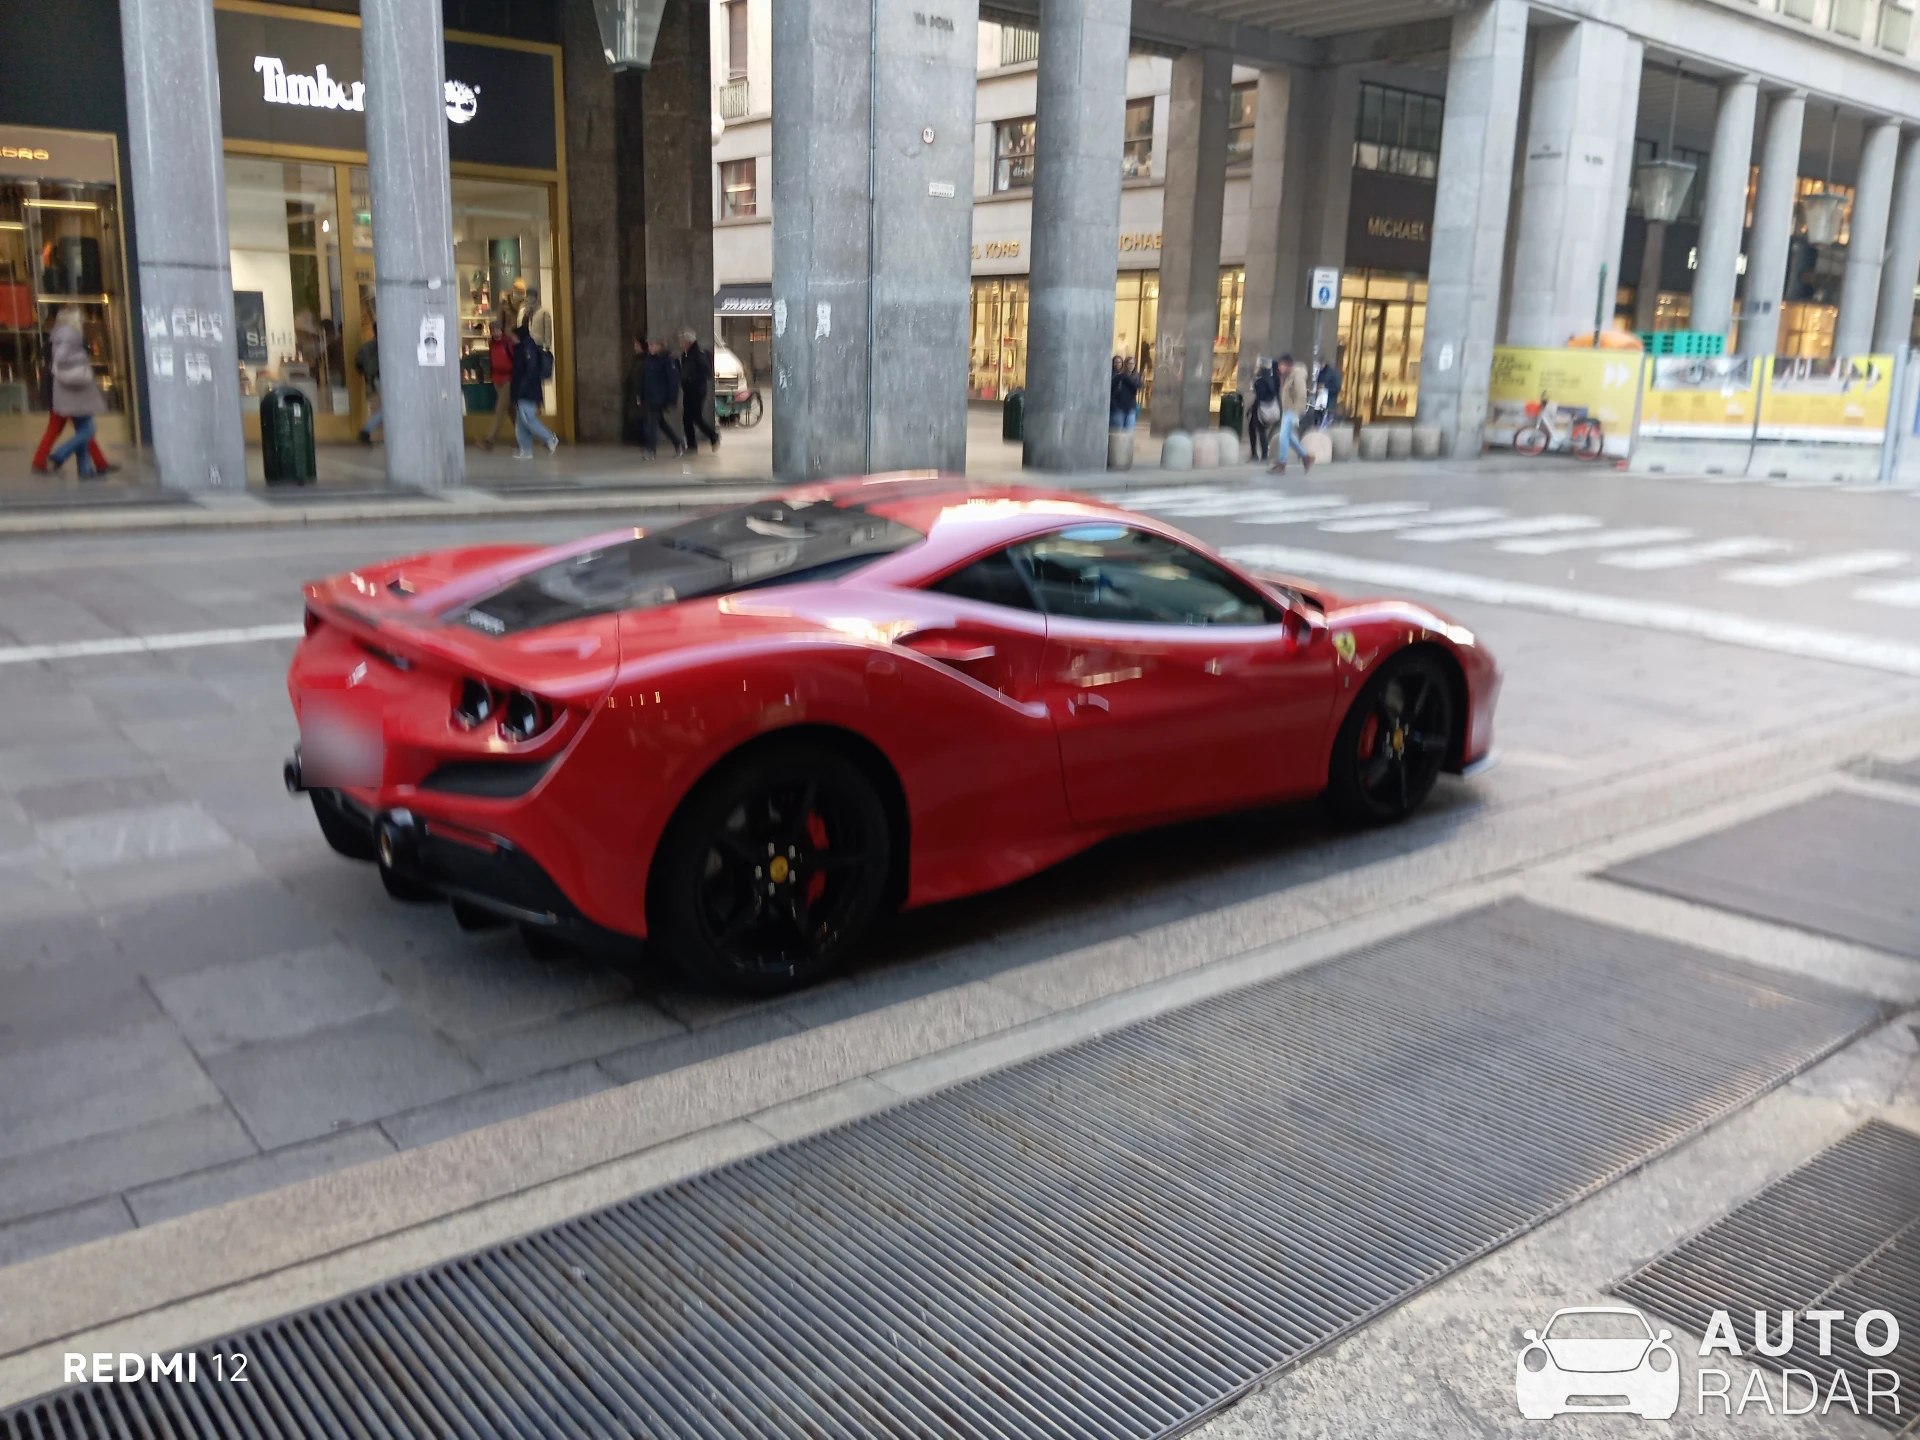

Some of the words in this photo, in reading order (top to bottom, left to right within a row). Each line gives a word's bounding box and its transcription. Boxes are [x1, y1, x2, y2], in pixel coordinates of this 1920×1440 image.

[253, 55, 366, 112] Timber
[1367, 216, 1425, 242] MICHAEL
[985, 239, 1020, 259] KORS
[1118, 232, 1162, 252] ICHAE
[720, 299, 772, 311] STARBUCKS
